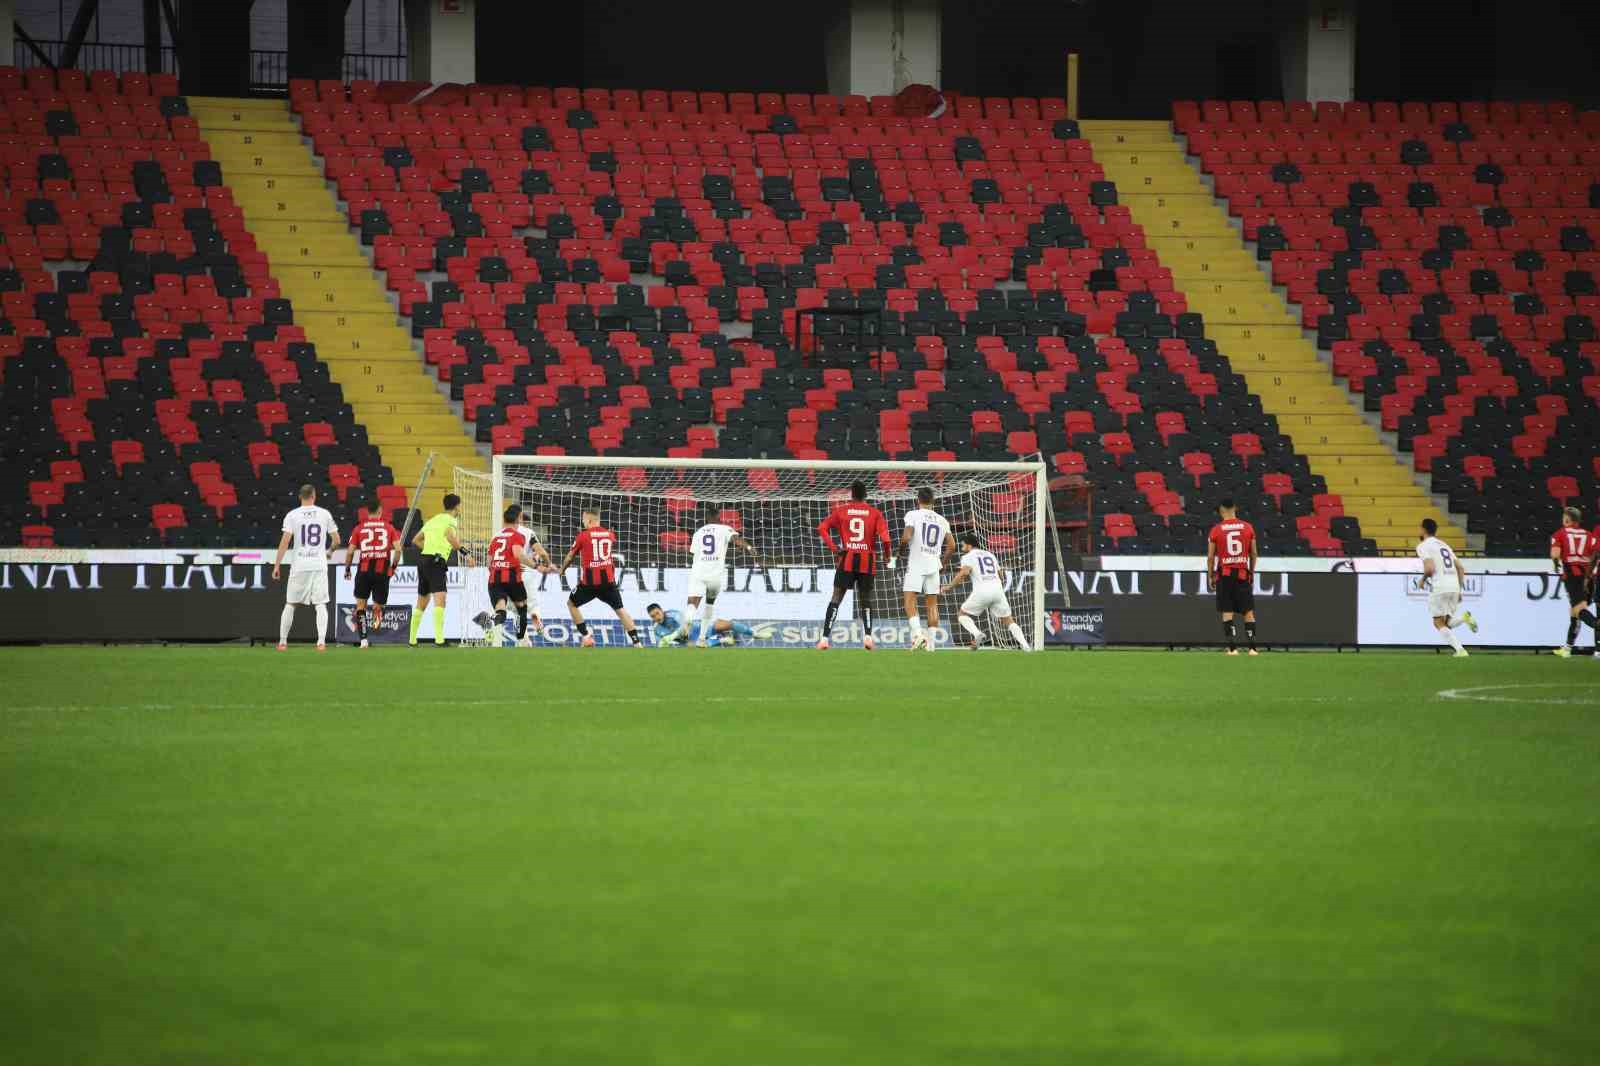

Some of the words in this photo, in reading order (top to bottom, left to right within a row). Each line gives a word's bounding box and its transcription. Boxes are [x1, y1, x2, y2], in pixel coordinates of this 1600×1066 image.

[301, 523, 322, 547] 18
[360, 528, 388, 552] 23
[849, 517, 865, 543] 9
[921, 522, 940, 548] 10
[493, 538, 508, 561] 2
[591, 538, 613, 562] 10
[702, 534, 716, 556] 9
[1226, 530, 1244, 557] 6
[1567, 533, 1588, 556] 17
[977, 556, 996, 575] 19
[1440, 547, 1453, 569] 8
